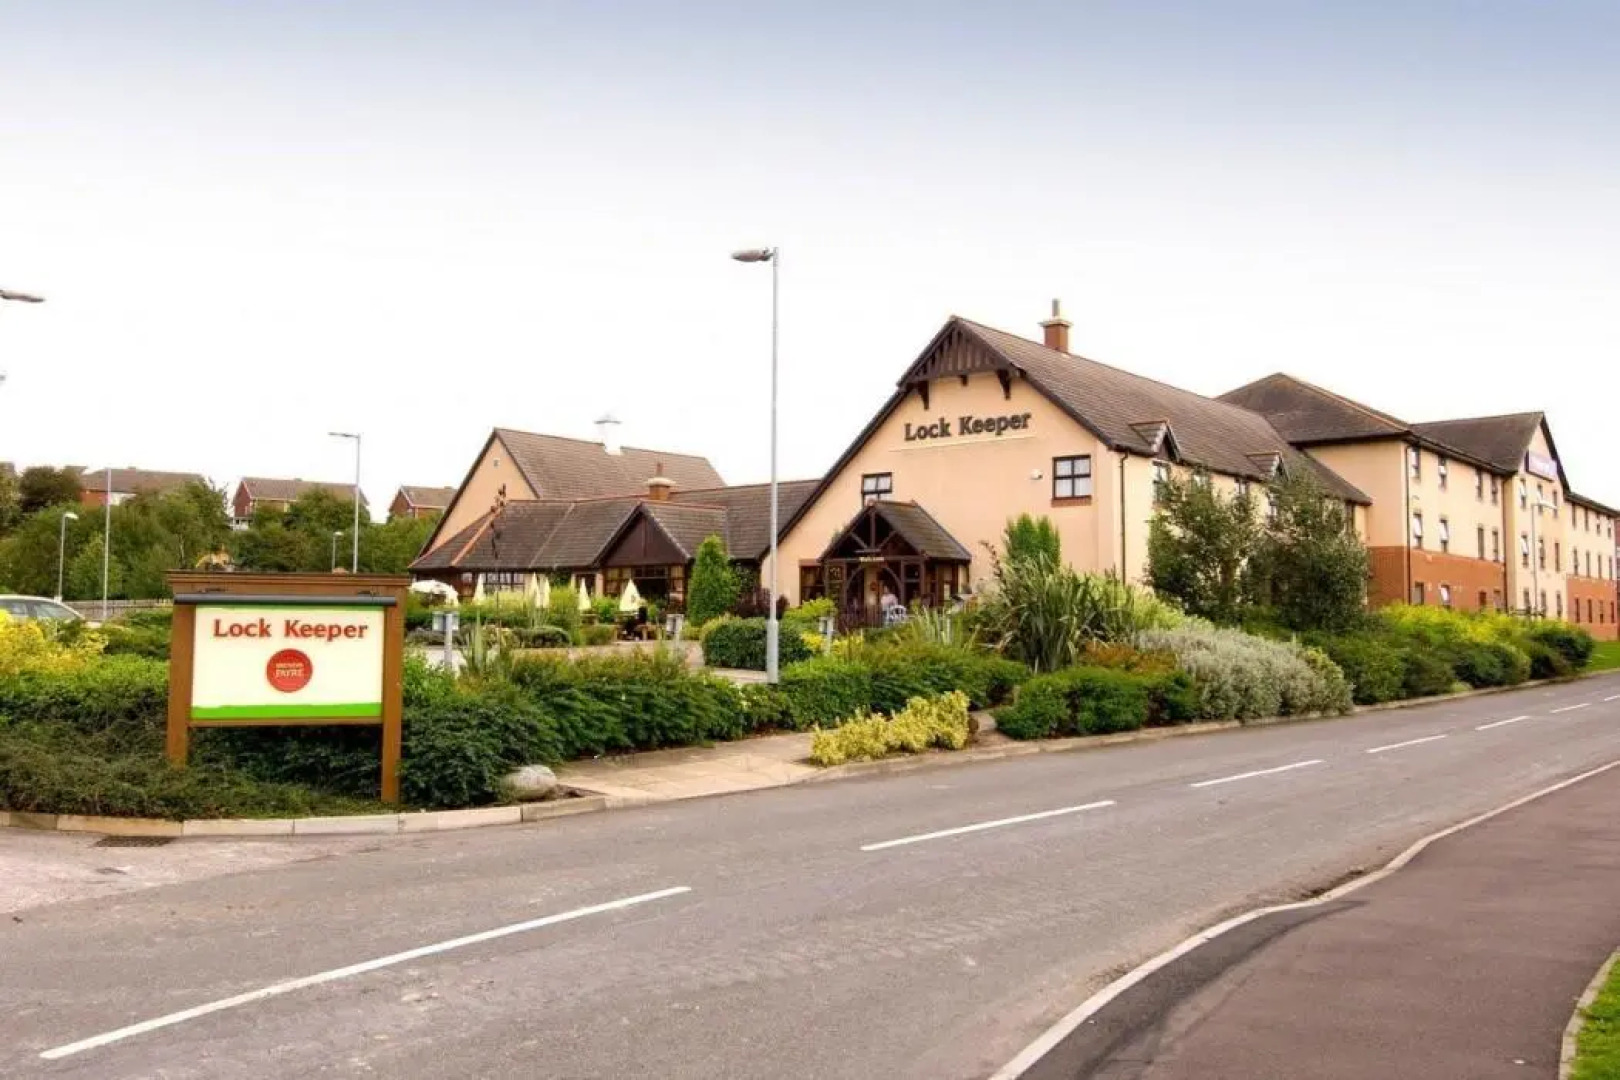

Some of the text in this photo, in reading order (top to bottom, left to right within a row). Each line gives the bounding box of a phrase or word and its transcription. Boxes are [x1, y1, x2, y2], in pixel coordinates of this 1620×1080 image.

[904, 412, 1031, 441] Lock Keeper
[213, 618, 368, 642] Lock Keeper
